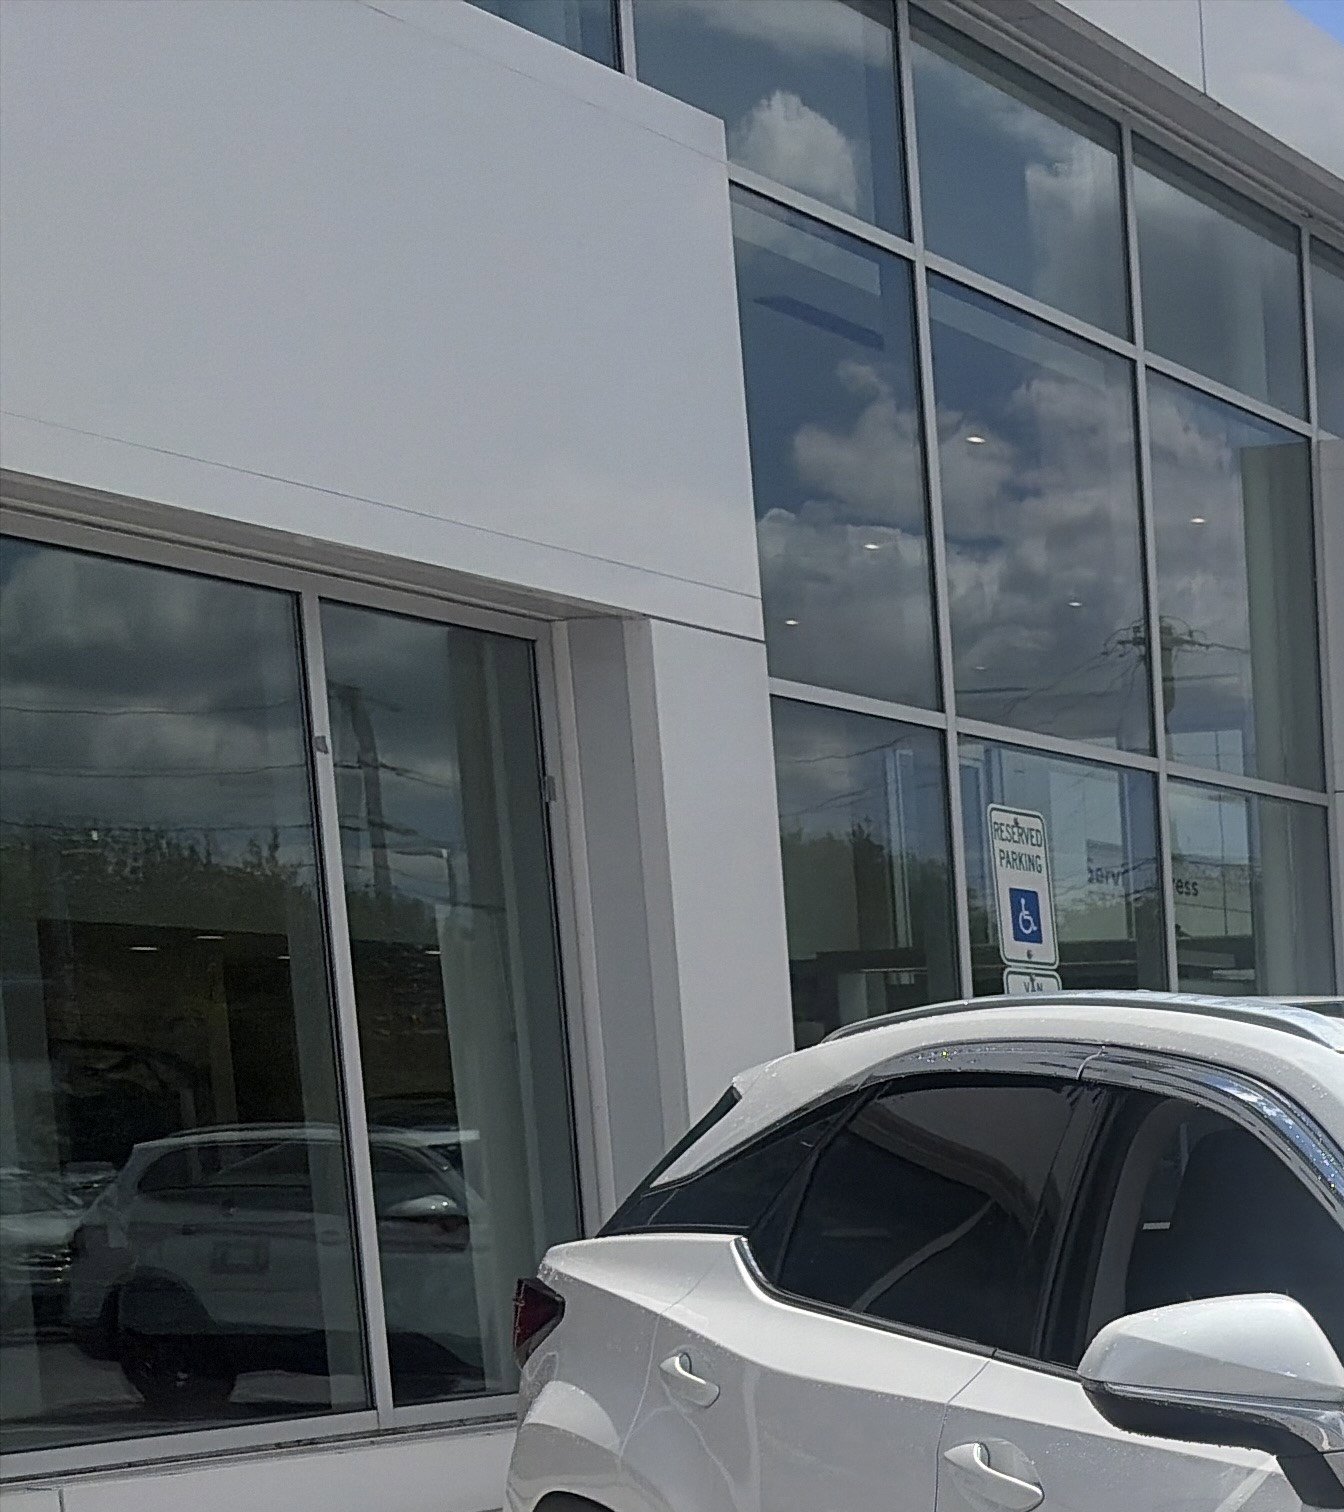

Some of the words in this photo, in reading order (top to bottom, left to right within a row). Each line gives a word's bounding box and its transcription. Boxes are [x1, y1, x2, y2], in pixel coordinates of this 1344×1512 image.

[993, 822, 1043, 848] RESERVED
[1000, 849, 1043, 874] PARKING
[1023, 980, 1043, 993] VAN
